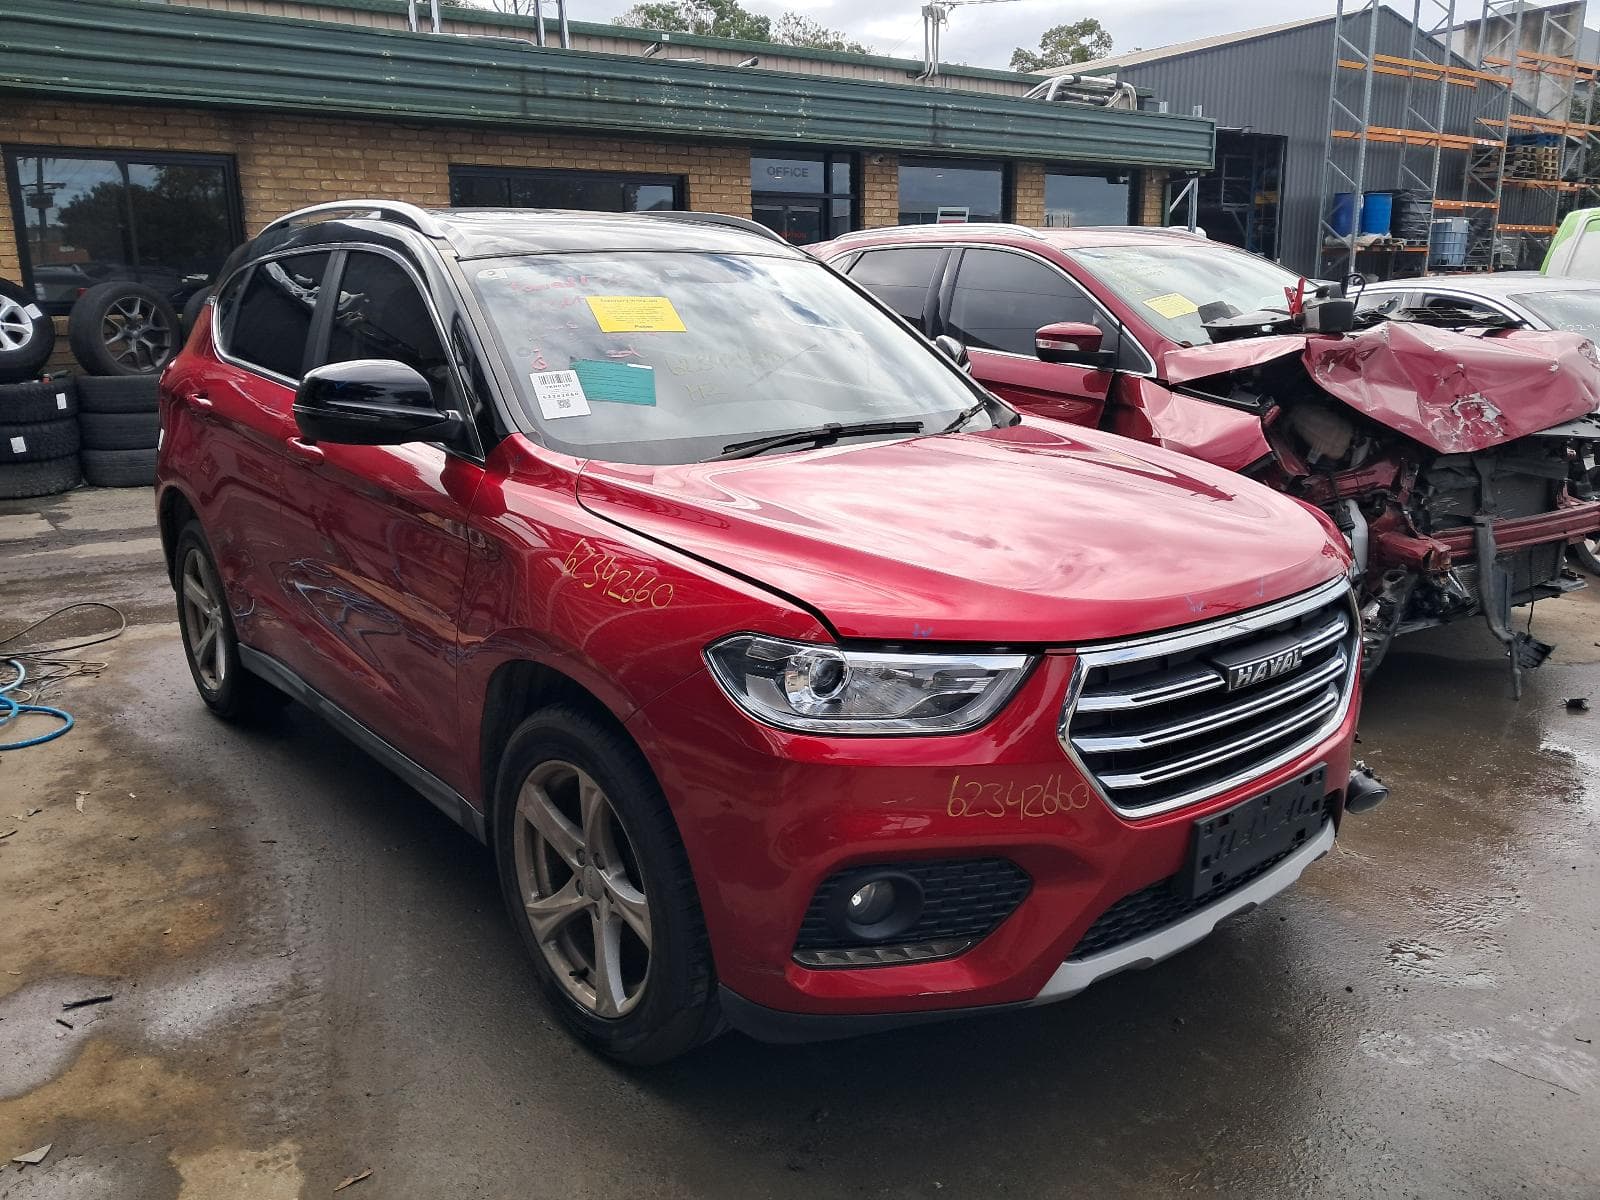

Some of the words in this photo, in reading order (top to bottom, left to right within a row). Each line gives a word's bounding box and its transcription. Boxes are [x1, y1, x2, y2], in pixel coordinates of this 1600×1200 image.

[767, 166, 809, 178] OFFICE
[563, 537, 674, 610] 62342660
[1234, 648, 1303, 688] HAVAL
[946, 774, 1090, 821] 62342660
